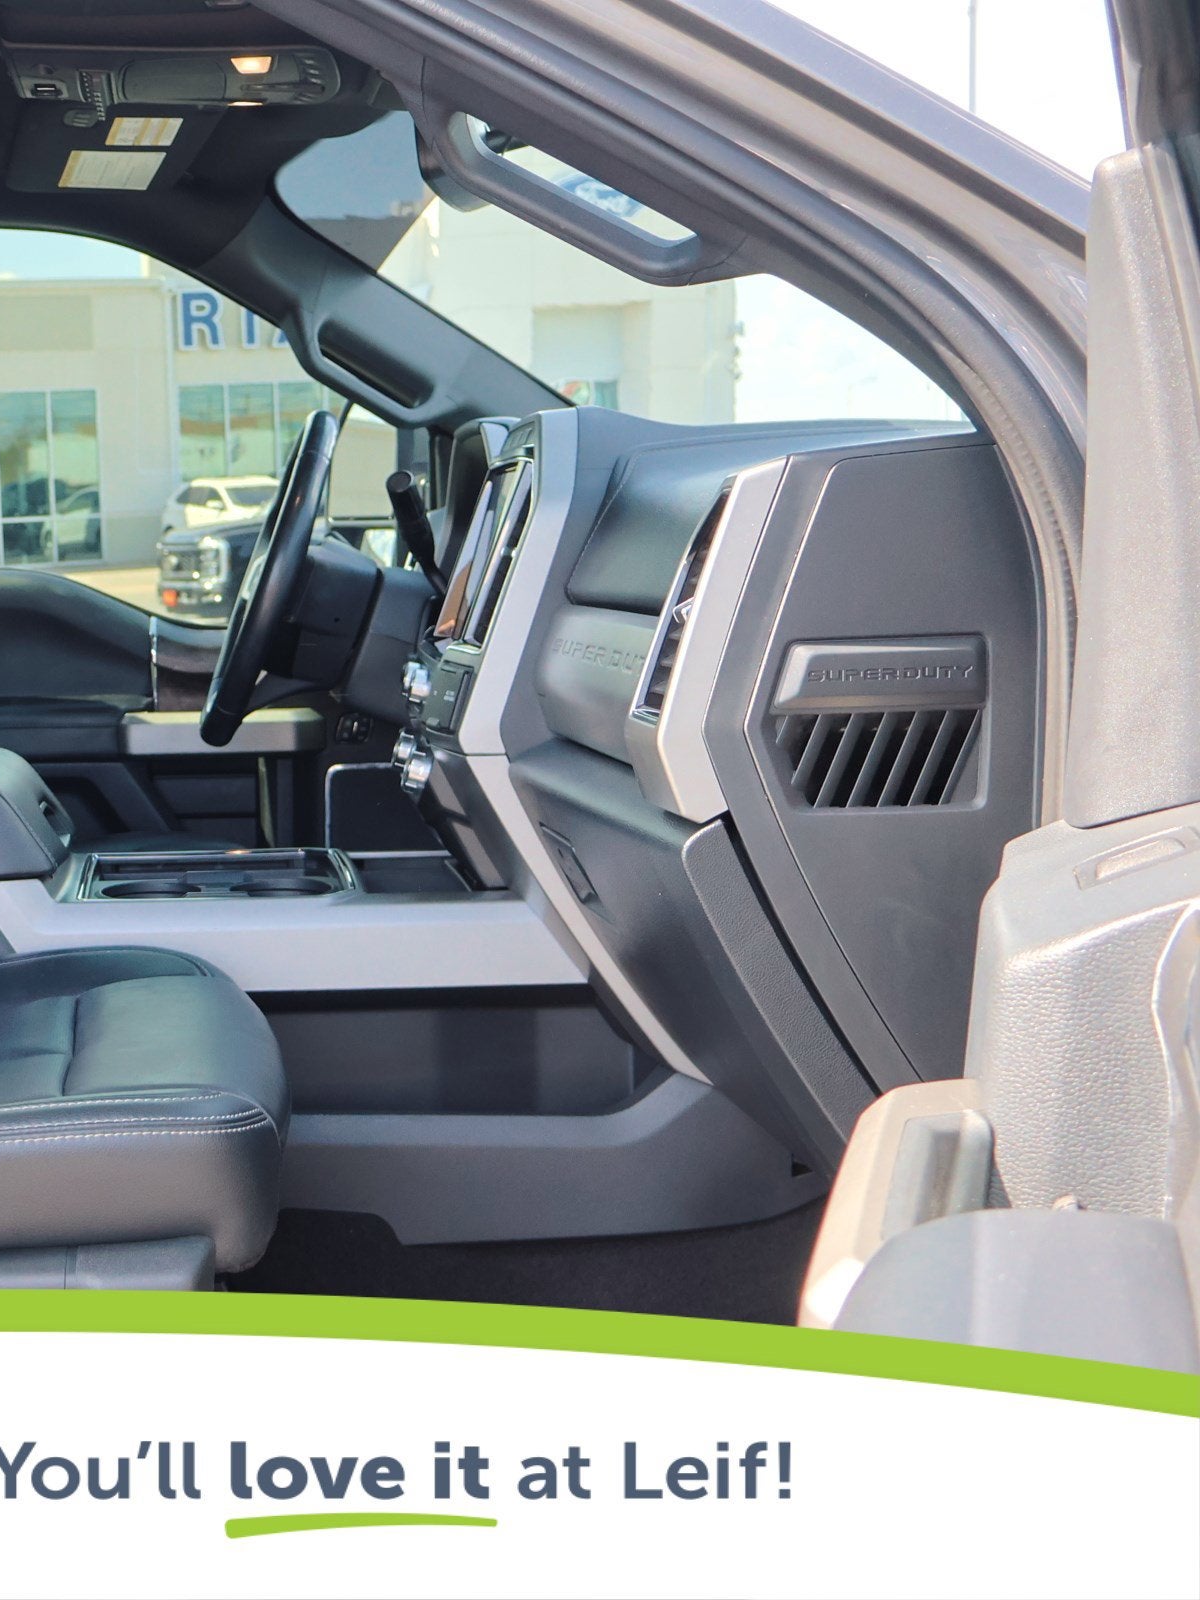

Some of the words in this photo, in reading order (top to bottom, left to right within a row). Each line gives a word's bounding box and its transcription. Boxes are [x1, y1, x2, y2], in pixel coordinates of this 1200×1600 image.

[181, 292, 288, 346] RI
[552, 638, 606, 667] SUPER
[807, 667, 899, 682] SUPER
[902, 665, 975, 680] DUTY
